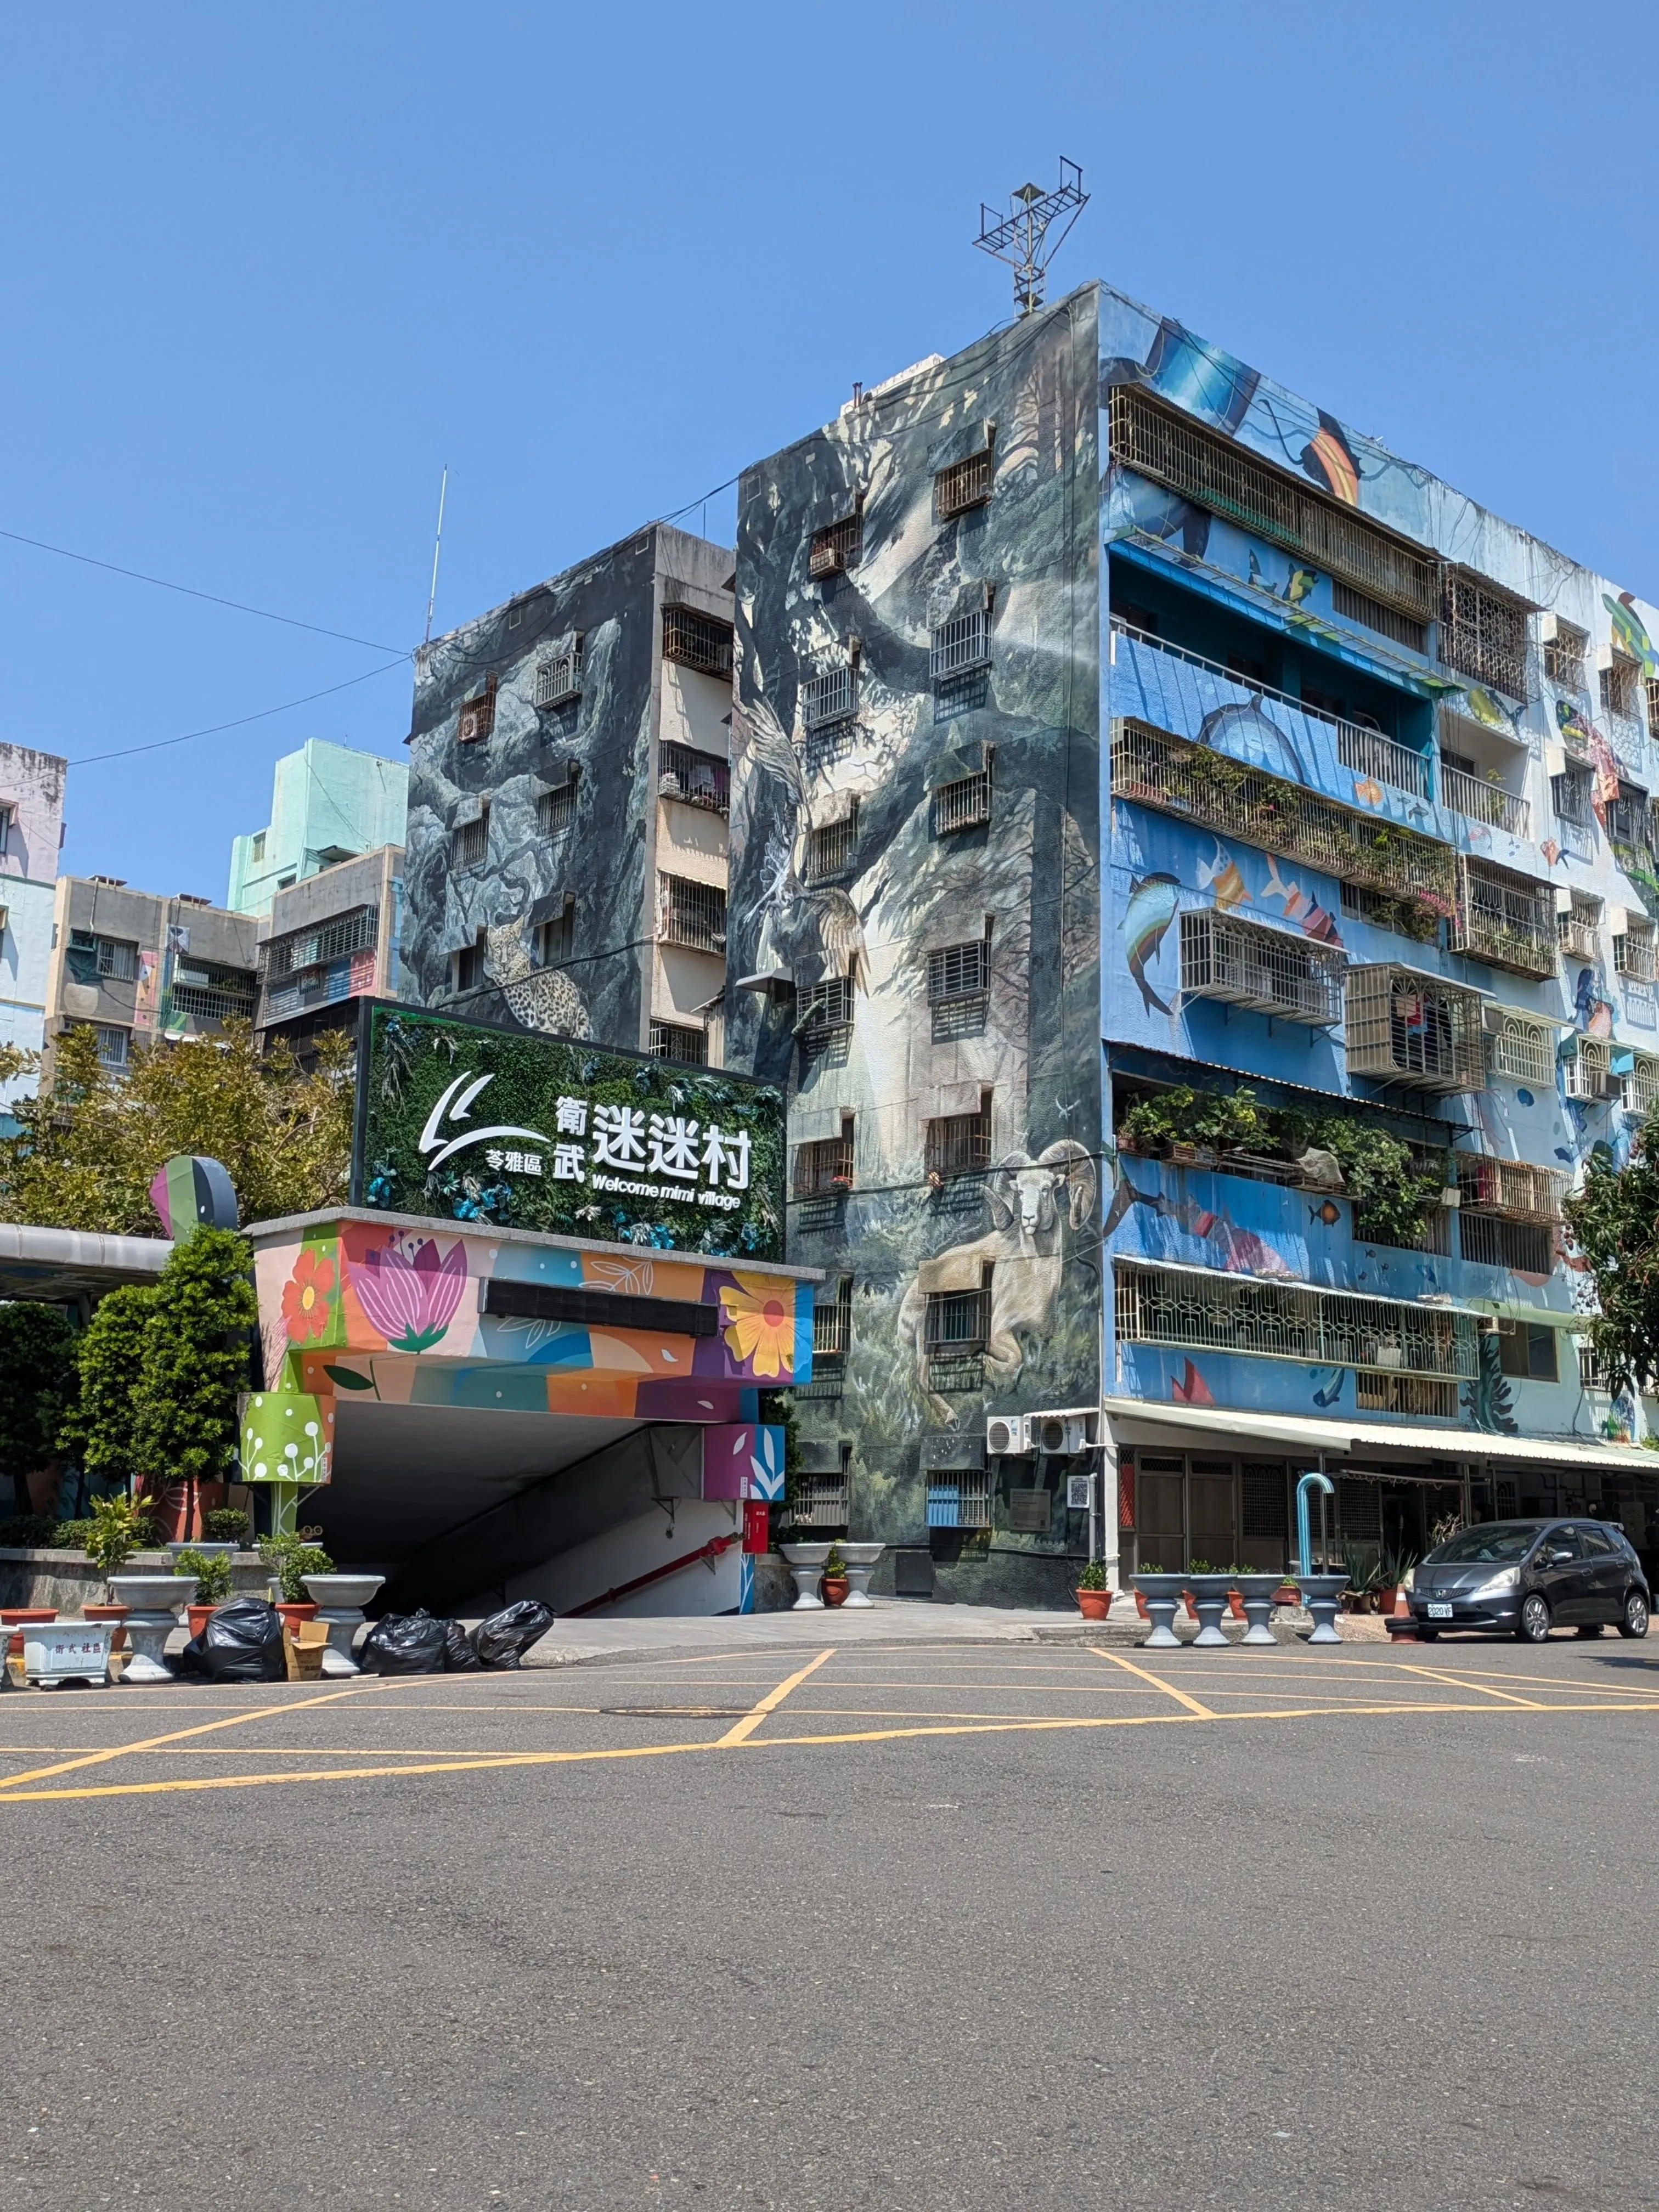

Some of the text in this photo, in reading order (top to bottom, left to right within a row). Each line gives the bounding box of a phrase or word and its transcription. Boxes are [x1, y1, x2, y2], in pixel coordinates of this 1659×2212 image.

[486, 1149, 543, 1176] 苓雅區
[553, 1096, 588, 1183] 衛武
[591, 1104, 752, 1189] 迷迷村
[592, 1174, 741, 1210] Welcome mimi village
